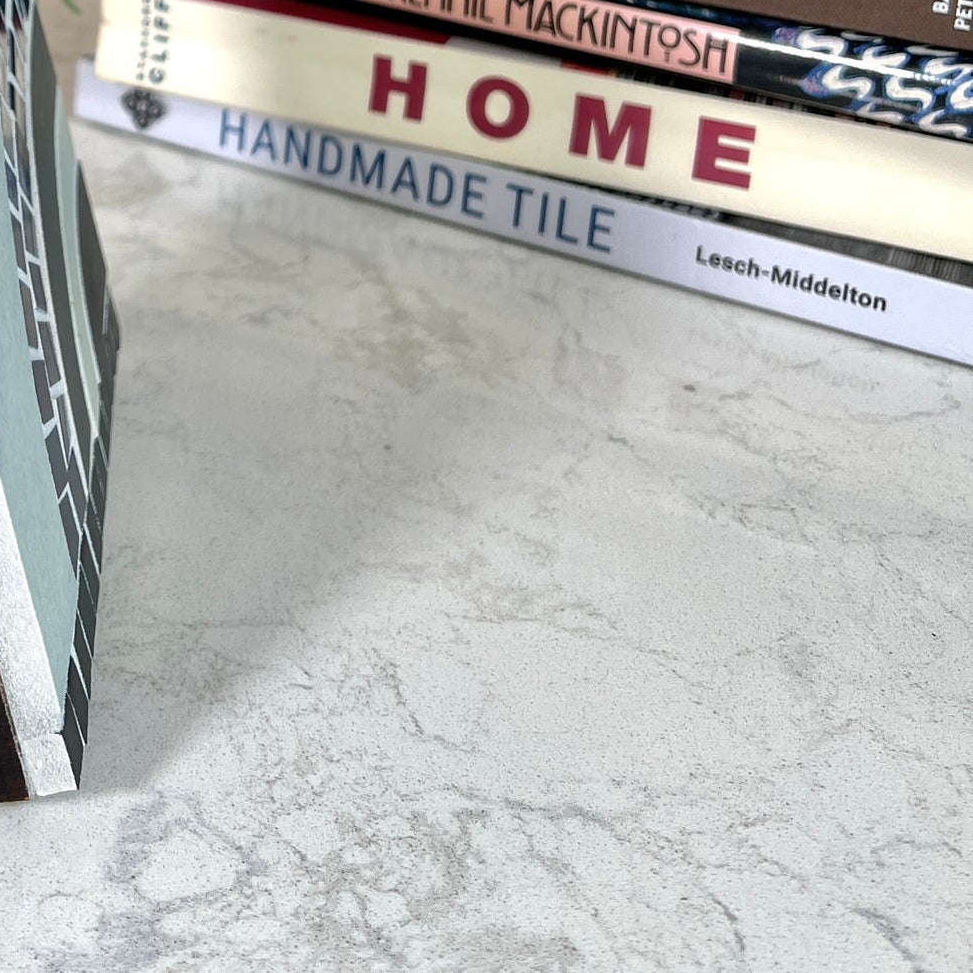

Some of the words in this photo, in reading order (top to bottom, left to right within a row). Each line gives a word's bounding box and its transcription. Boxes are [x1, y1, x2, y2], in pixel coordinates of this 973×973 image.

[218, 107, 488, 219] HANDMADE
[505, 181, 616, 254] TILE
[368, 52, 757, 191] HOME
[695, 244, 888, 312] Lesch-Middelton
